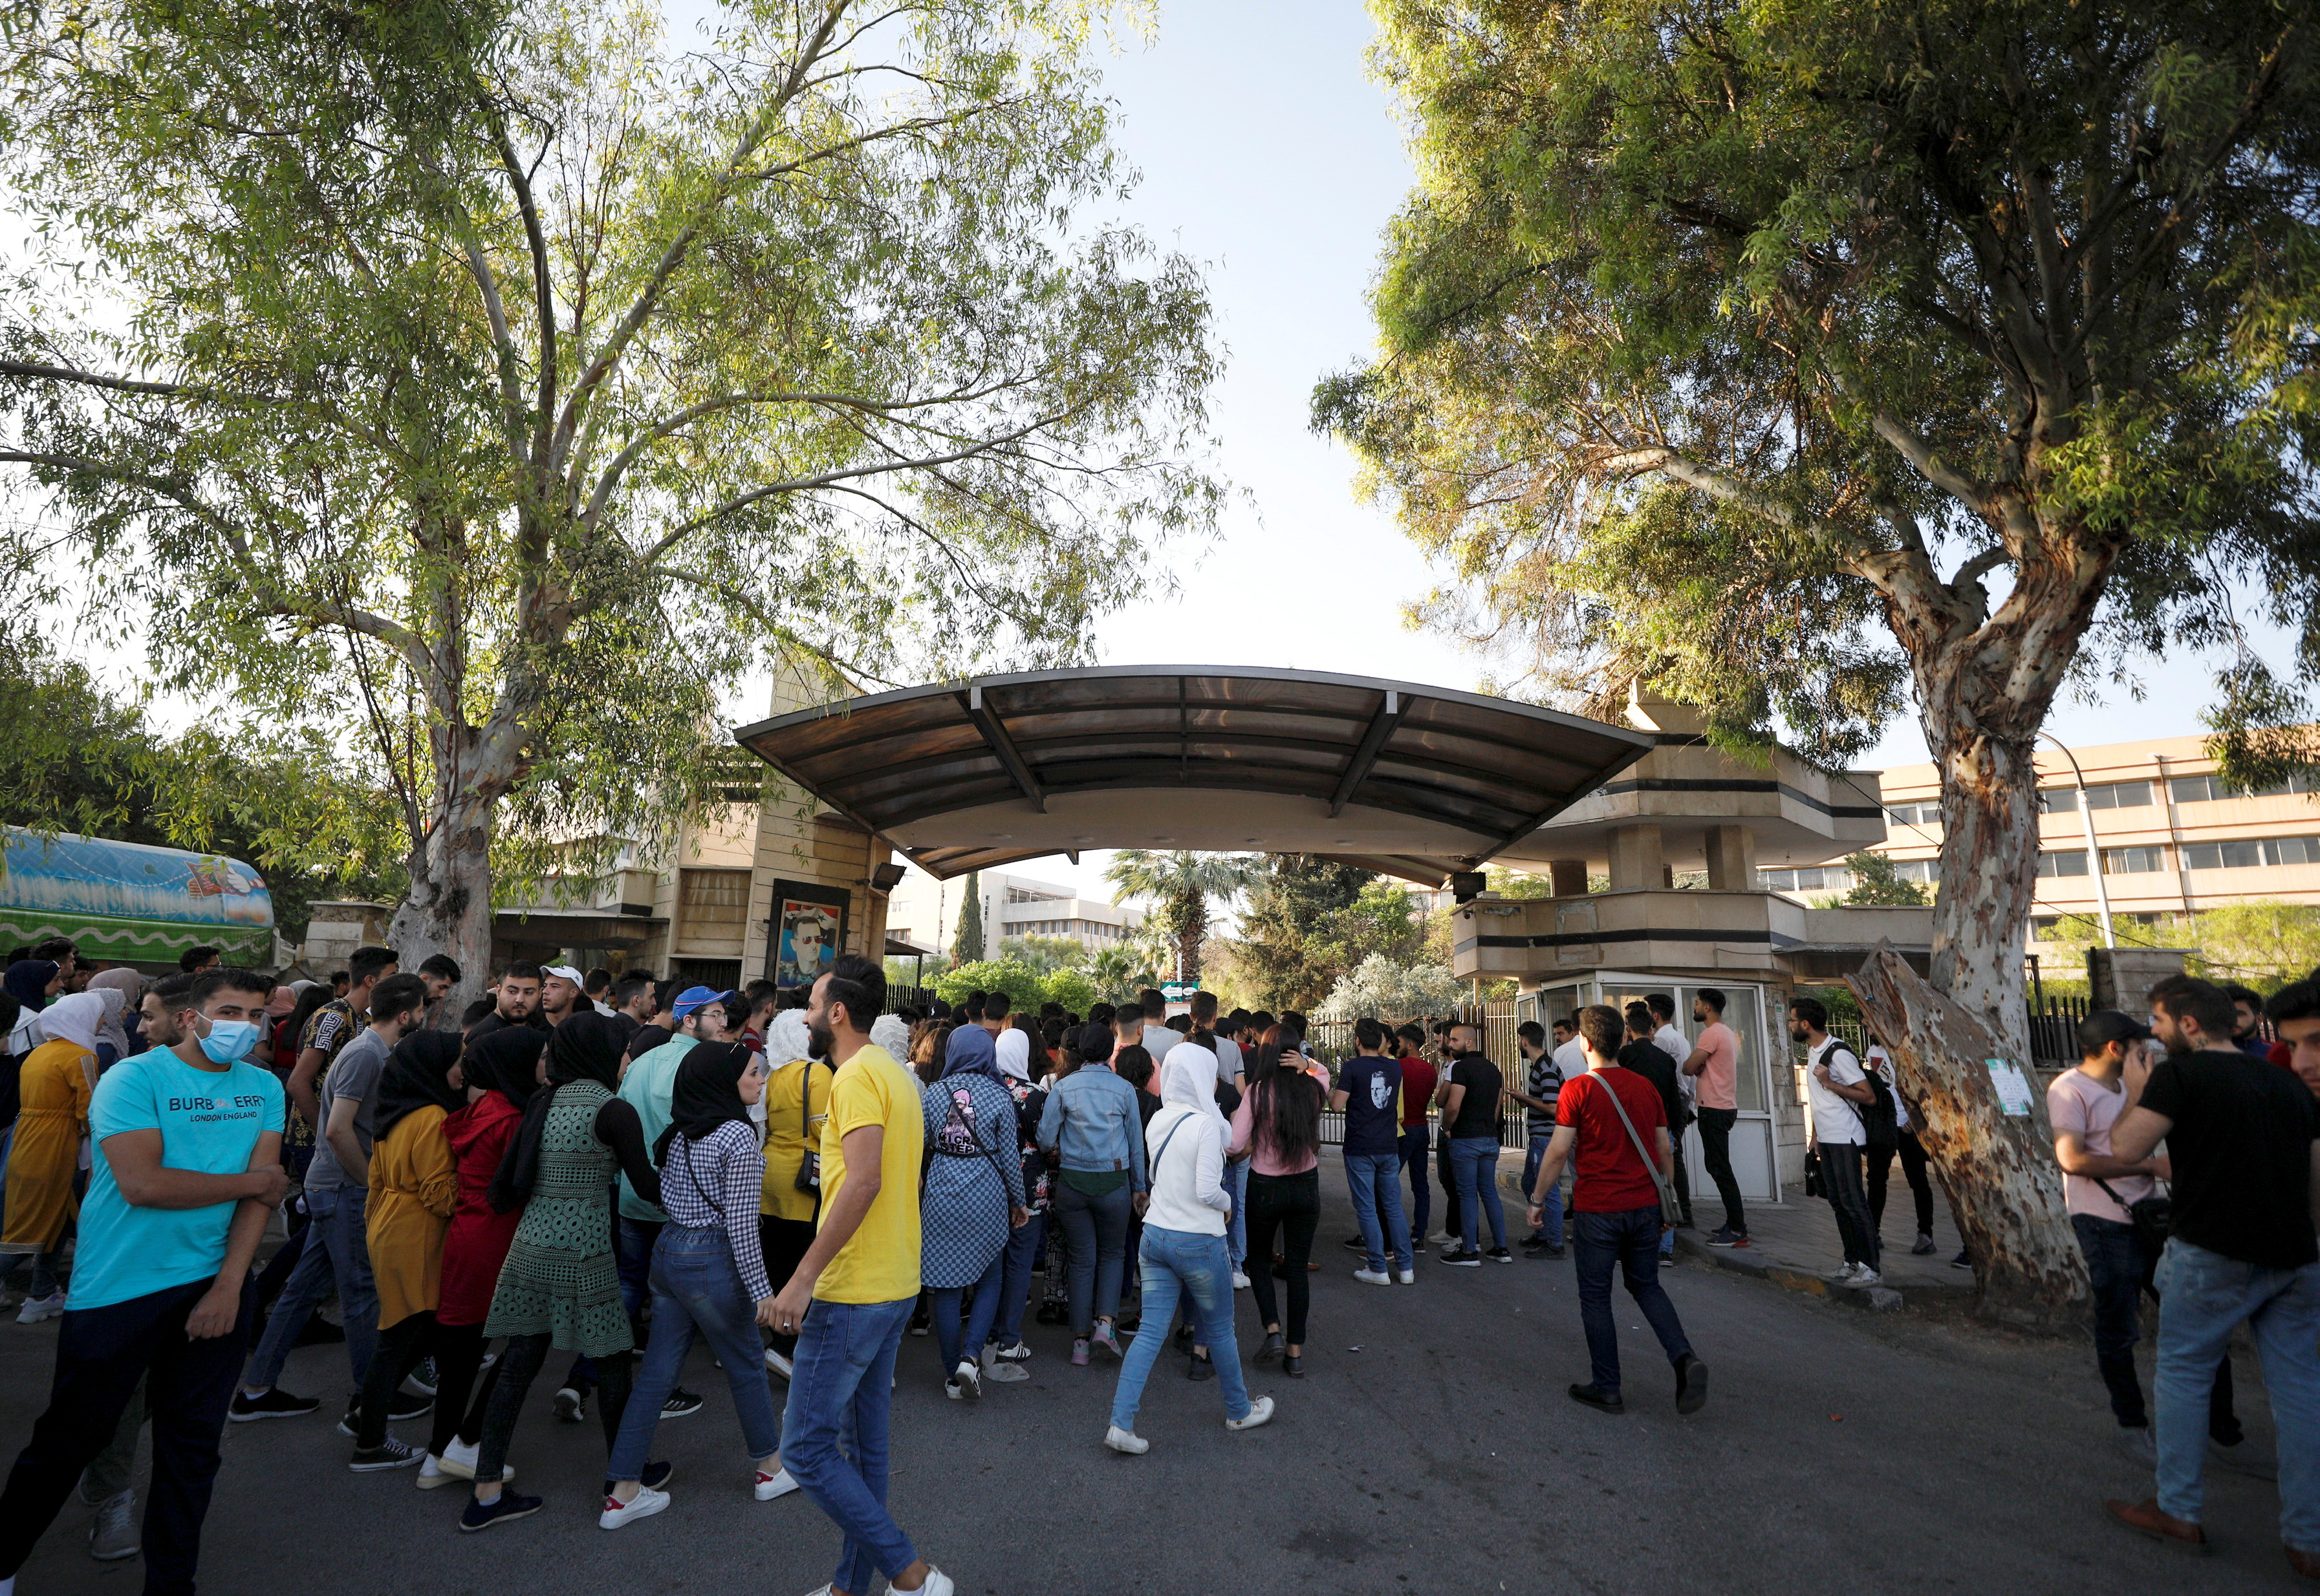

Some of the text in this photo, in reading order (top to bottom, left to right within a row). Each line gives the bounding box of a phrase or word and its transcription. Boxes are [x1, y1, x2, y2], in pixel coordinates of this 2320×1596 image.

[190, 1110, 257, 1122] LONDON ENGLAND
[938, 1132, 975, 1145] MICR
[939, 1143, 975, 1154] STEP
